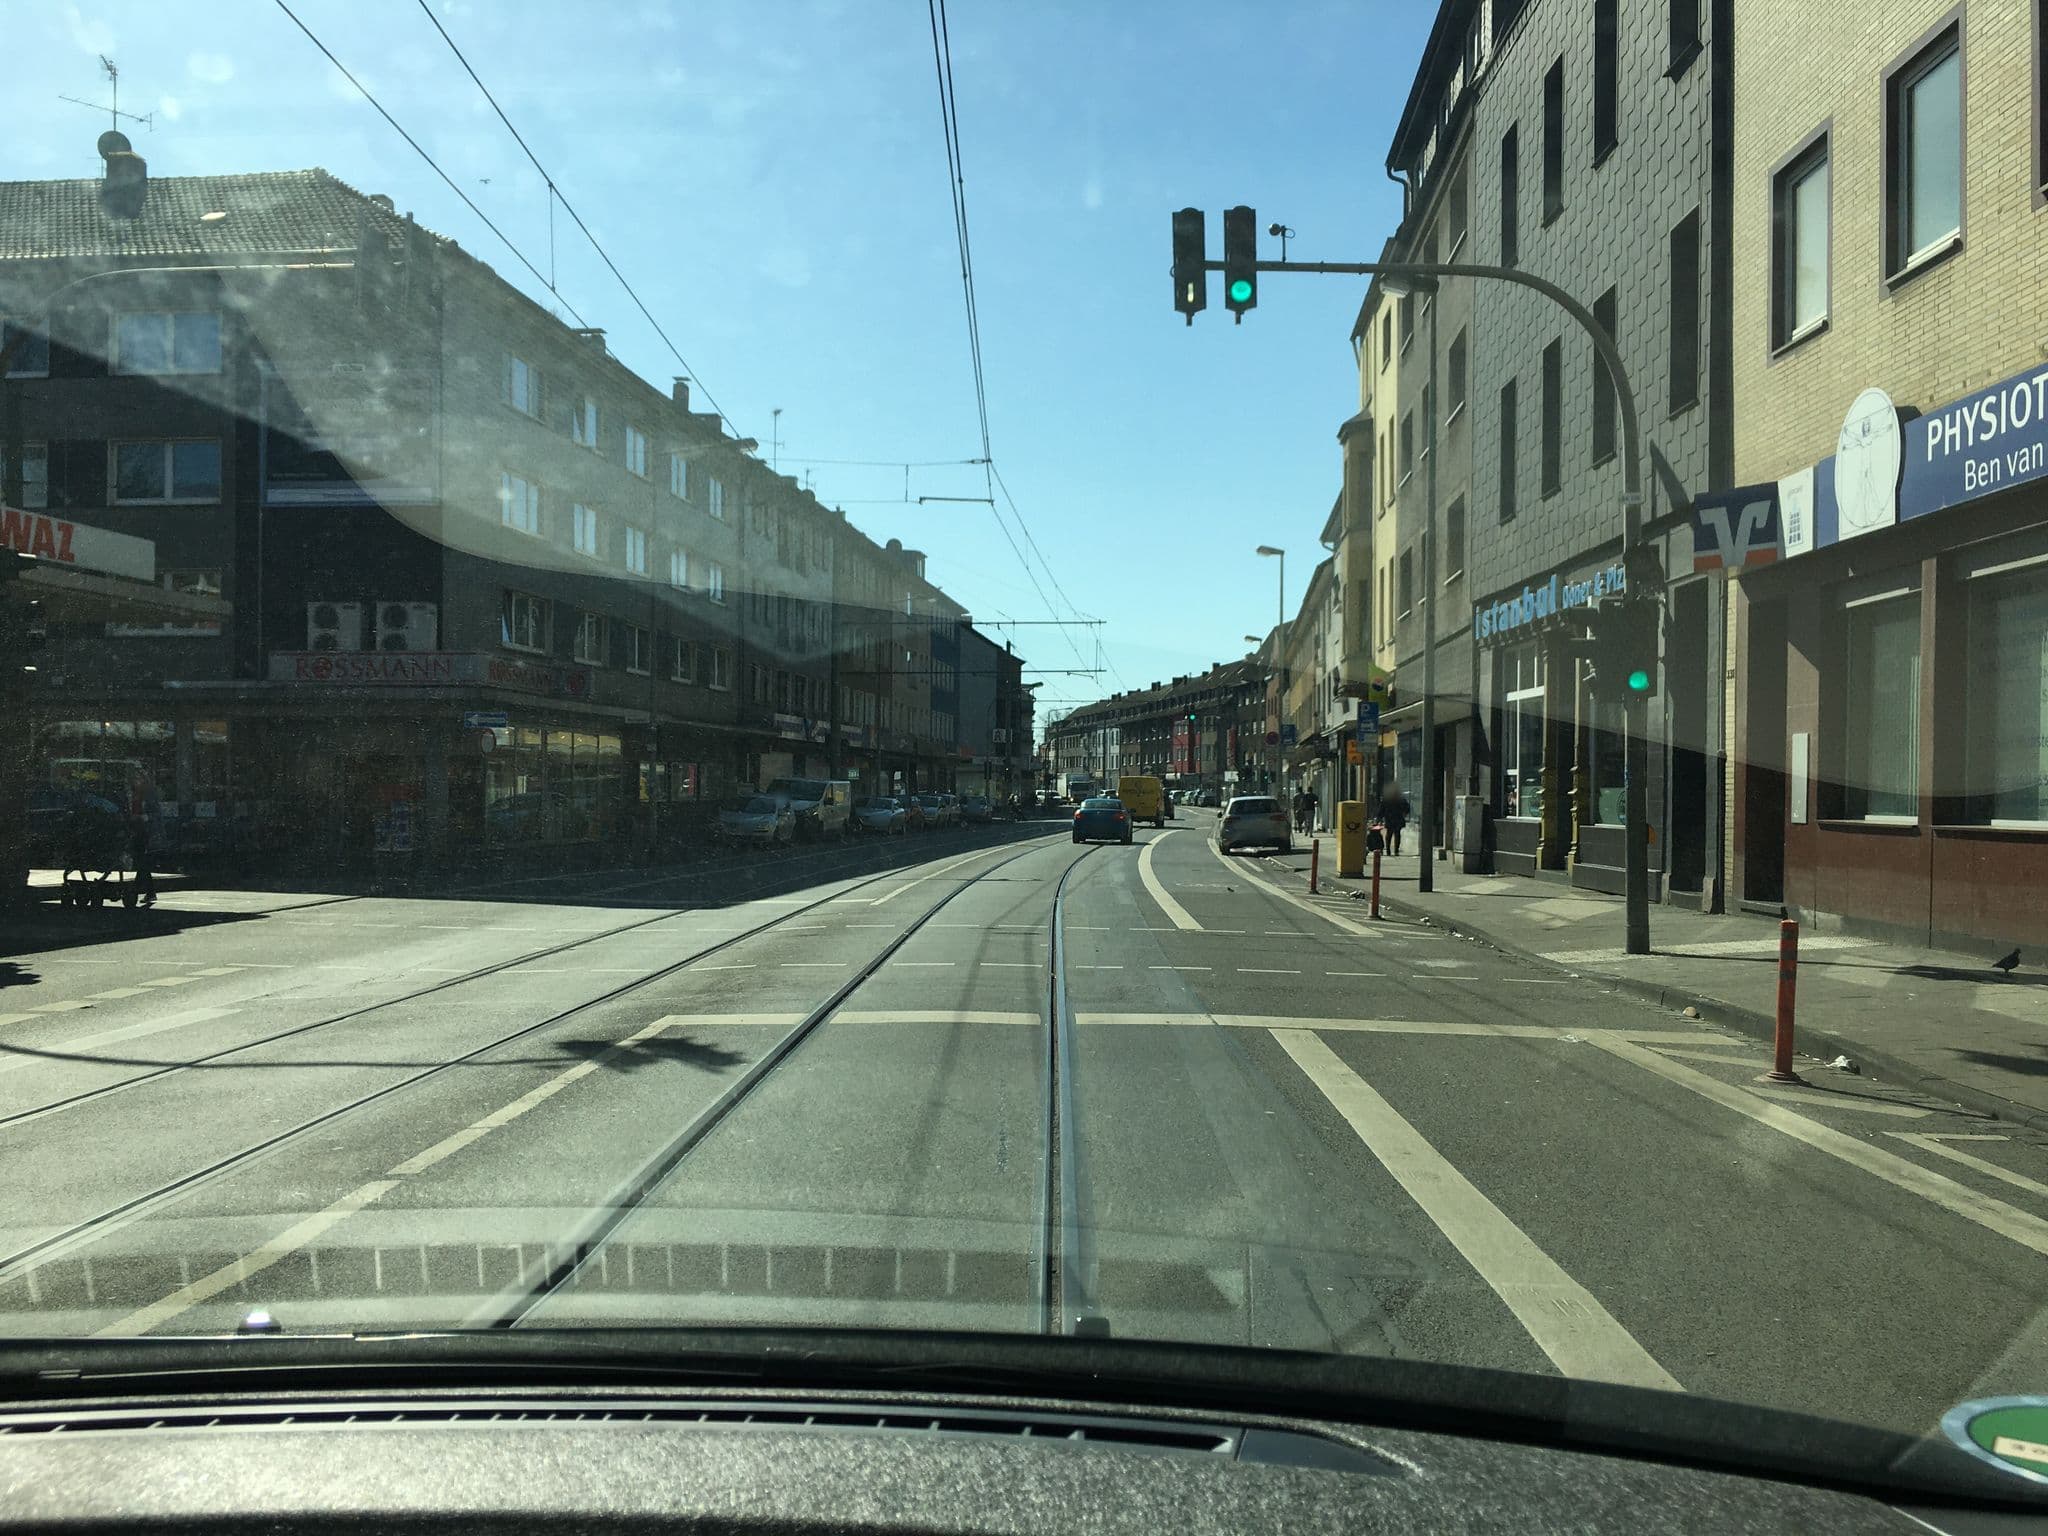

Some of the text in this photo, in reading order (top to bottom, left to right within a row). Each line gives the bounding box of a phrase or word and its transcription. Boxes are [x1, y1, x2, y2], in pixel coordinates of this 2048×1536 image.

[1927, 371, 2048, 463] PHYSIOT
[1964, 442, 2044, 492] Ben van
[0, 510, 76, 562] WAZ
[1475, 574, 1557, 640] istanbul
[295, 656, 451, 680] ROSSMANN
